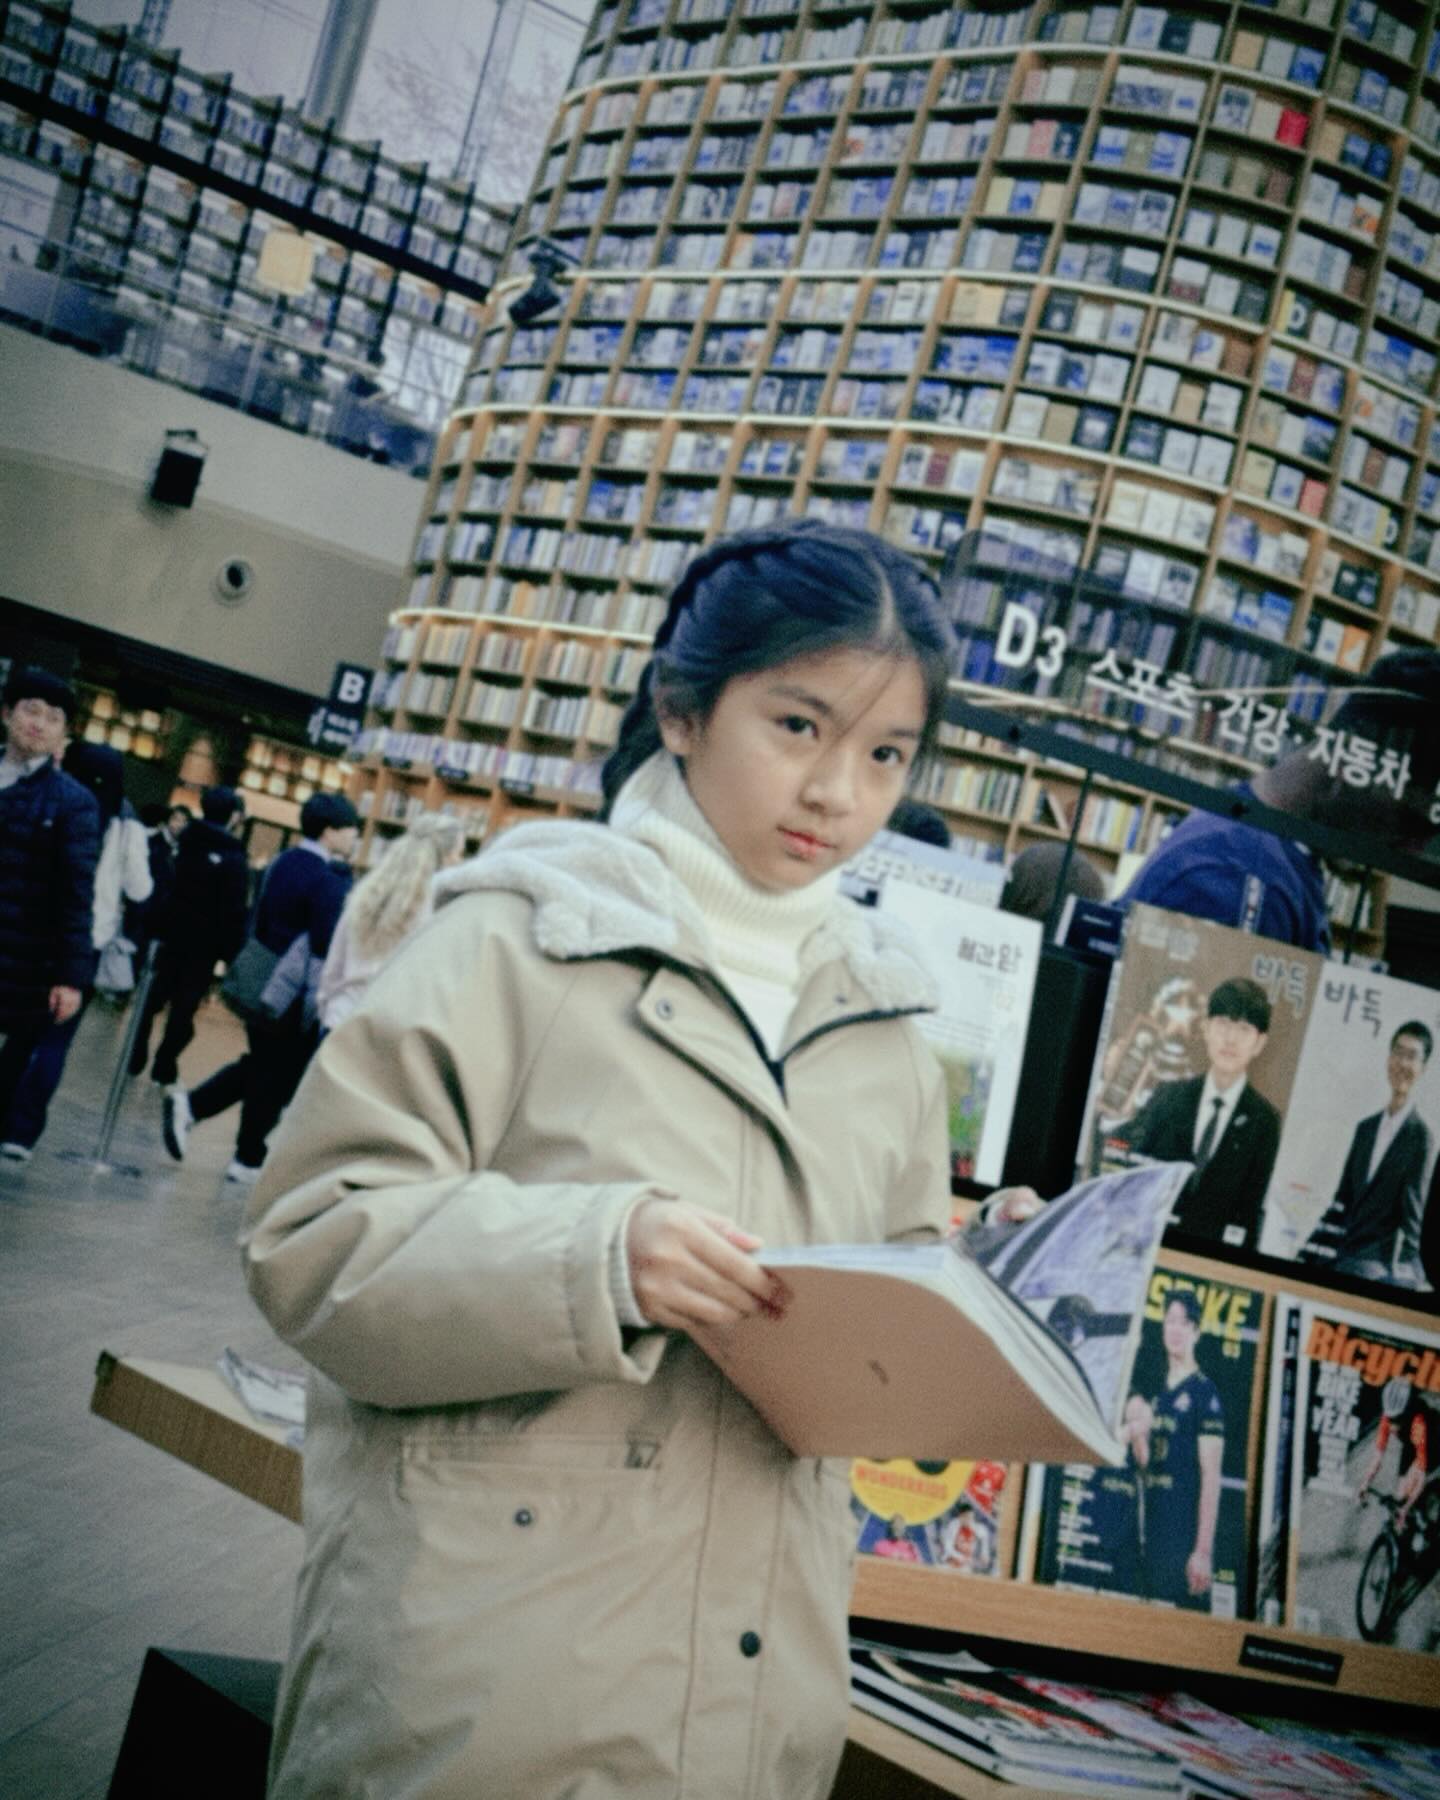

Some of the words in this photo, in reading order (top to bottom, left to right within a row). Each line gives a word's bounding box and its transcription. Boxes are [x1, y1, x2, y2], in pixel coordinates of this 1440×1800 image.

[995, 602, 1067, 678] D3
[338, 671, 366, 703] B
[1325, 980, 1382, 1038] 바둑
[1144, 1273, 1251, 1340] SKE
[1311, 1405, 1361, 1441] YEAR
